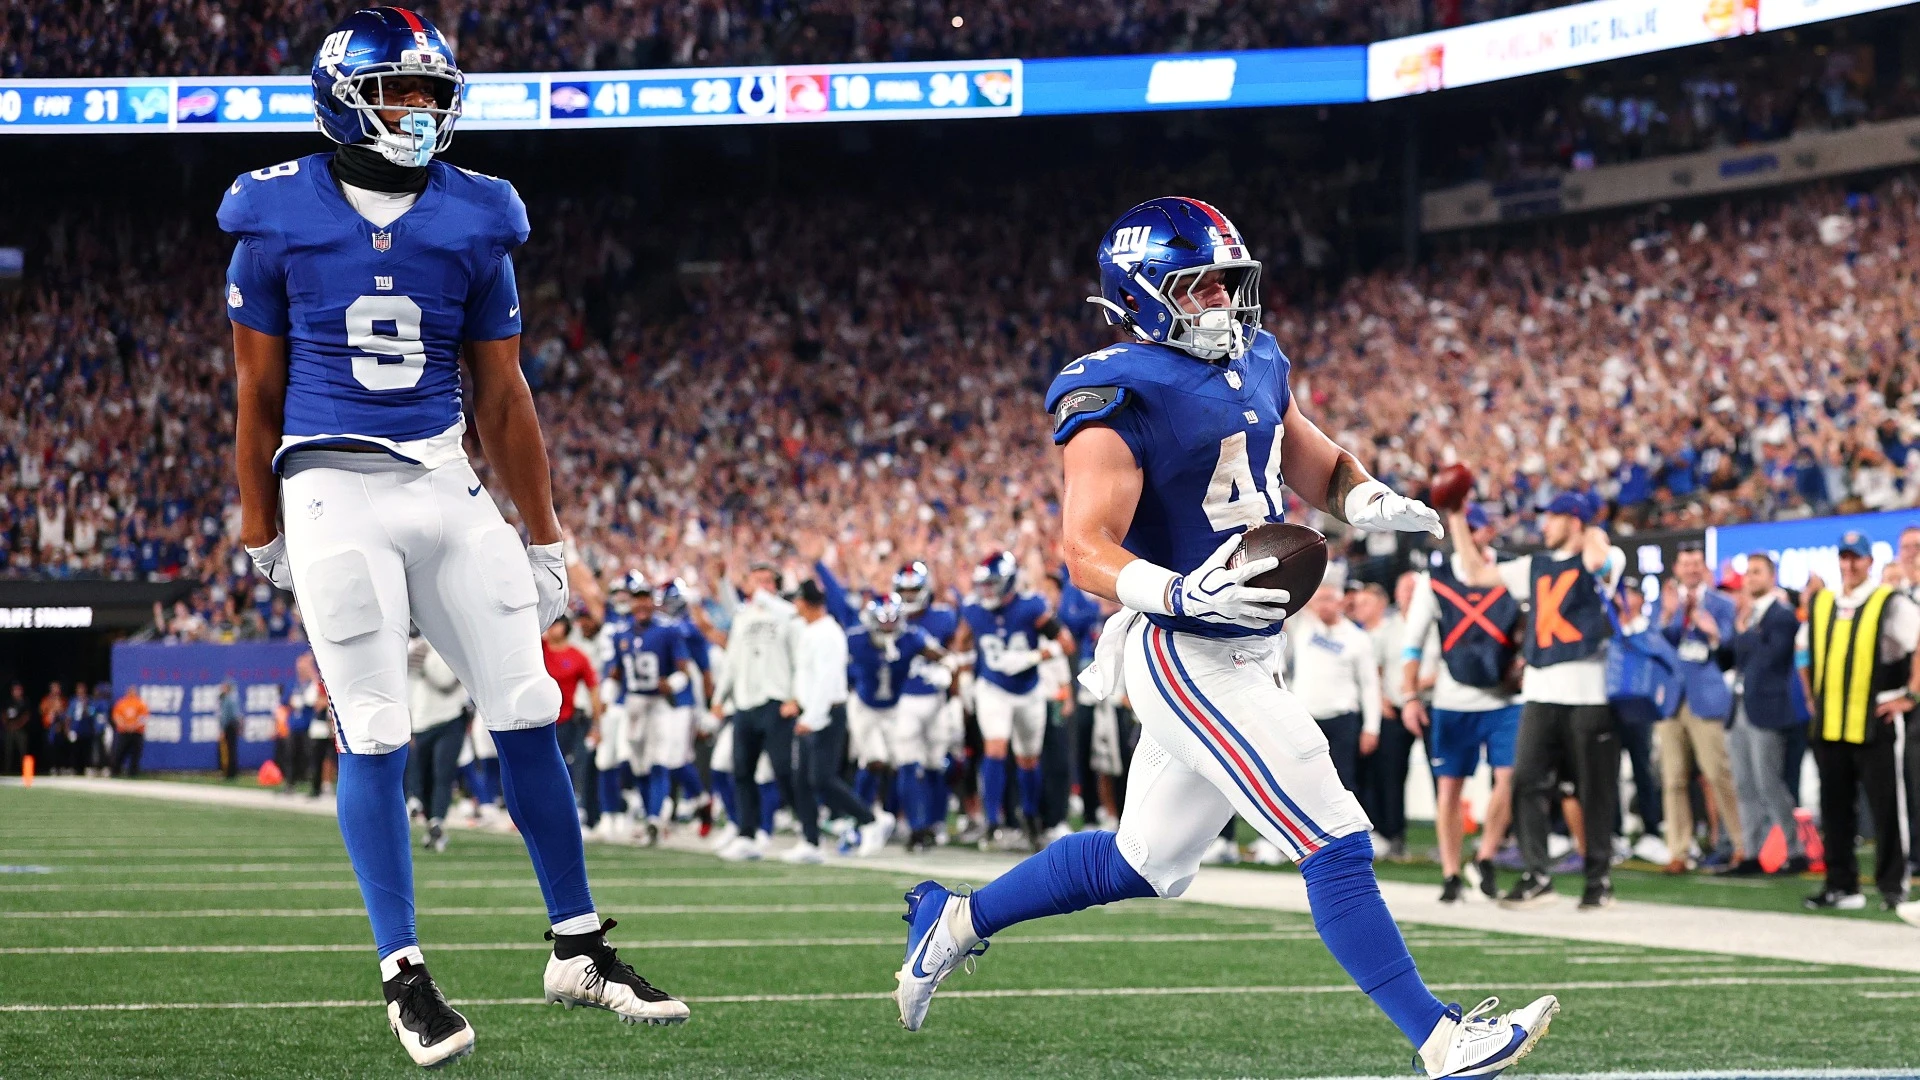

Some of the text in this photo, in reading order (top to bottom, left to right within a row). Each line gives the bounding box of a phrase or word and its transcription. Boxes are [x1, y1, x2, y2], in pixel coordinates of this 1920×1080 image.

[84, 90, 118, 121] 31
[594, 83, 630, 115] 41
[692, 80, 732, 113] 23
[832, 75, 870, 109] 10
[929, 73, 969, 106] 34
[346, 295, 426, 391] 9
[1536, 569, 1583, 648] K
[621, 651, 660, 692] 19
[876, 665, 893, 700] 1
